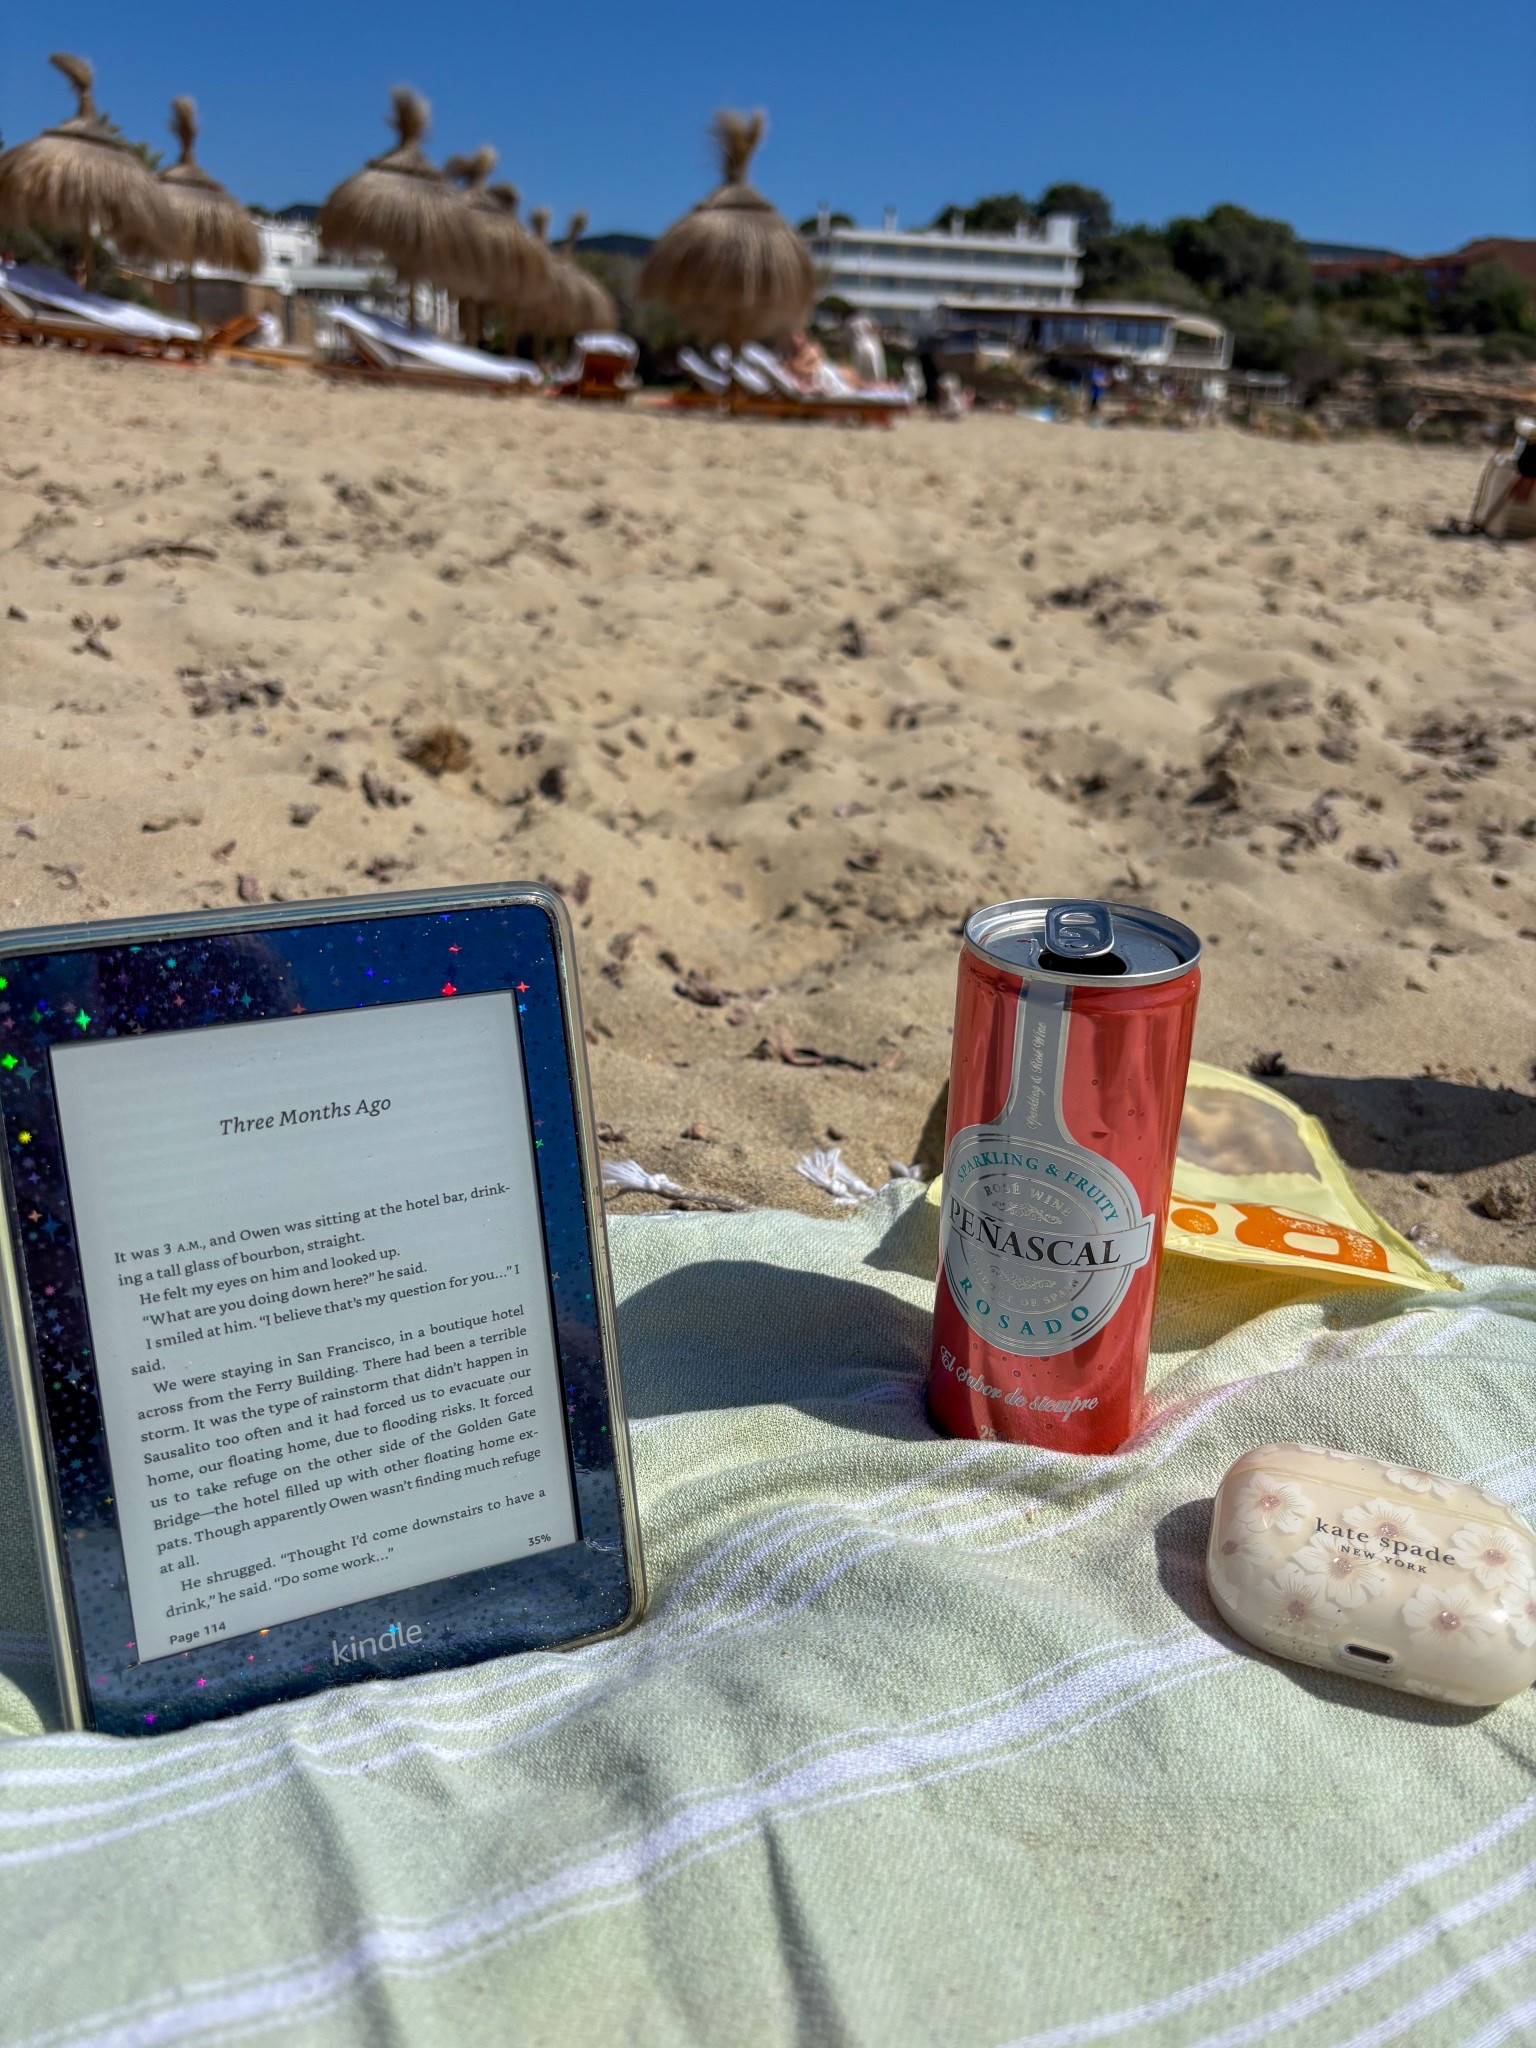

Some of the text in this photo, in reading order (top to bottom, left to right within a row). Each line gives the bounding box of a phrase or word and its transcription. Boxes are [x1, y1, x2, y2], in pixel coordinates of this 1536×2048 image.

[219, 1098, 391, 1136] Three Months Ago
[957, 1151, 1119, 1222] SPARKLING & FRUITY
[1030, 1187, 1073, 1217] WINE
[114, 1182, 510, 1264] It was 3 A.M., and Owen was sitting at the hotel bar, drink-
[949, 1197, 1121, 1266] PEÑASCAL
[118, 1232, 365, 1287] ing a tall glass of bourbon, straight.
[139, 1249, 400, 1305] He felt my eyes on him and looked up.
[959, 1276, 1089, 1336] ROSADO
[131, 1358, 165, 1376] said.
[138, 1326, 527, 1420] across from the Ferry Building. There had been a terrible
[152, 1304, 524, 1394] We were staying in San Francisco, in a boutique hotel
[940, 1345, 1099, 1422] El Sabor de siempre
[141, 1425, 190, 1442] storm.
[193, 1419, 206, 1431] It
[209, 1413, 237, 1427] was
[241, 1406, 265, 1420] the
[268, 1400, 300, 1416] type
[303, 1392, 318, 1406] of
[321, 1380, 389, 1403] rainstorm
[392, 1372, 421, 1386] that
[465, 1352, 513, 1370] happen
[515, 1347, 530, 1358] in
[144, 1368, 531, 1465] Sausalito too often and it had forced us to evacuate our
[146, 1385, 534, 1487] home, our floating home, due to flooding risks. It forced
[150, 1409, 536, 1508] us to take refuge on the other side of the Golden Gate
[242, 1489, 280, 1509] hotel
[284, 1479, 320, 1498] filled
[324, 1477, 343, 1489] up
[347, 1466, 379, 1483] with
[384, 1458, 420, 1474] other
[424, 1445, 475, 1464] floating
[478, 1435, 515, 1451] home
[519, 1430, 538, 1441] ex-
[156, 1537, 192, 1556] pats.
[194, 1519, 251, 1543] Though
[254, 1501, 327, 1529] apparently
[329, 1493, 368, 1509] Owen
[415, 1469, 462, 1488] finding
[464, 1457, 500, 1476] much
[502, 1449, 541, 1466] refuge
[160, 1554, 200, 1574] at all.
[180, 1578, 201, 1592] He
[206, 1557, 276, 1585] shrugged.
[372, 1525, 408, 1541] come
[412, 1505, 483, 1531] downstairs
[487, 1501, 501, 1511] to
[505, 1492, 535, 1507] have
[539, 1489, 546, 1498] a
[528, 1533, 551, 1547] 35%
[1316, 1517, 1456, 1566] kate spade
[1341, 1545, 1427, 1574] NEW YORK
[169, 1621, 226, 1645] Page 114
[332, 1621, 423, 1666] kindle
